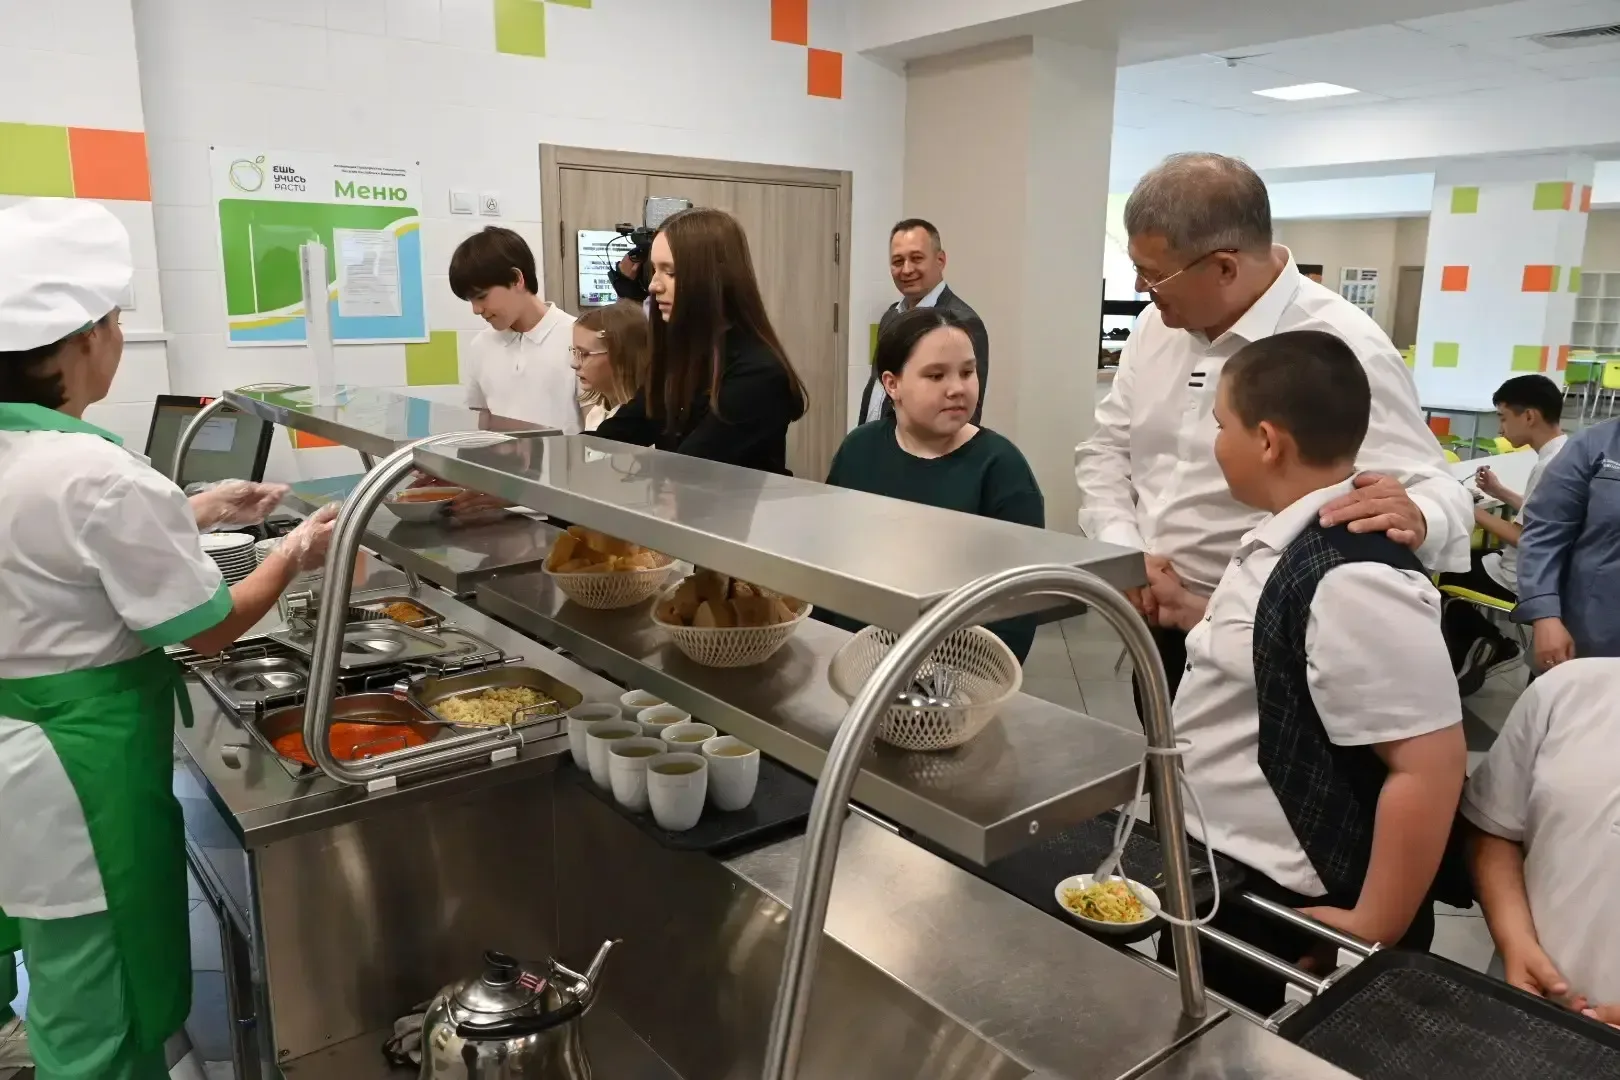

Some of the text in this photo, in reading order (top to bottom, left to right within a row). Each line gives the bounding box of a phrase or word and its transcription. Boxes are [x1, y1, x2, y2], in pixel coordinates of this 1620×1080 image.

[273, 174, 307, 183] УЧИСЬ
[274, 183, 306, 192] РАСТИ
[334, 179, 408, 201] Меню
